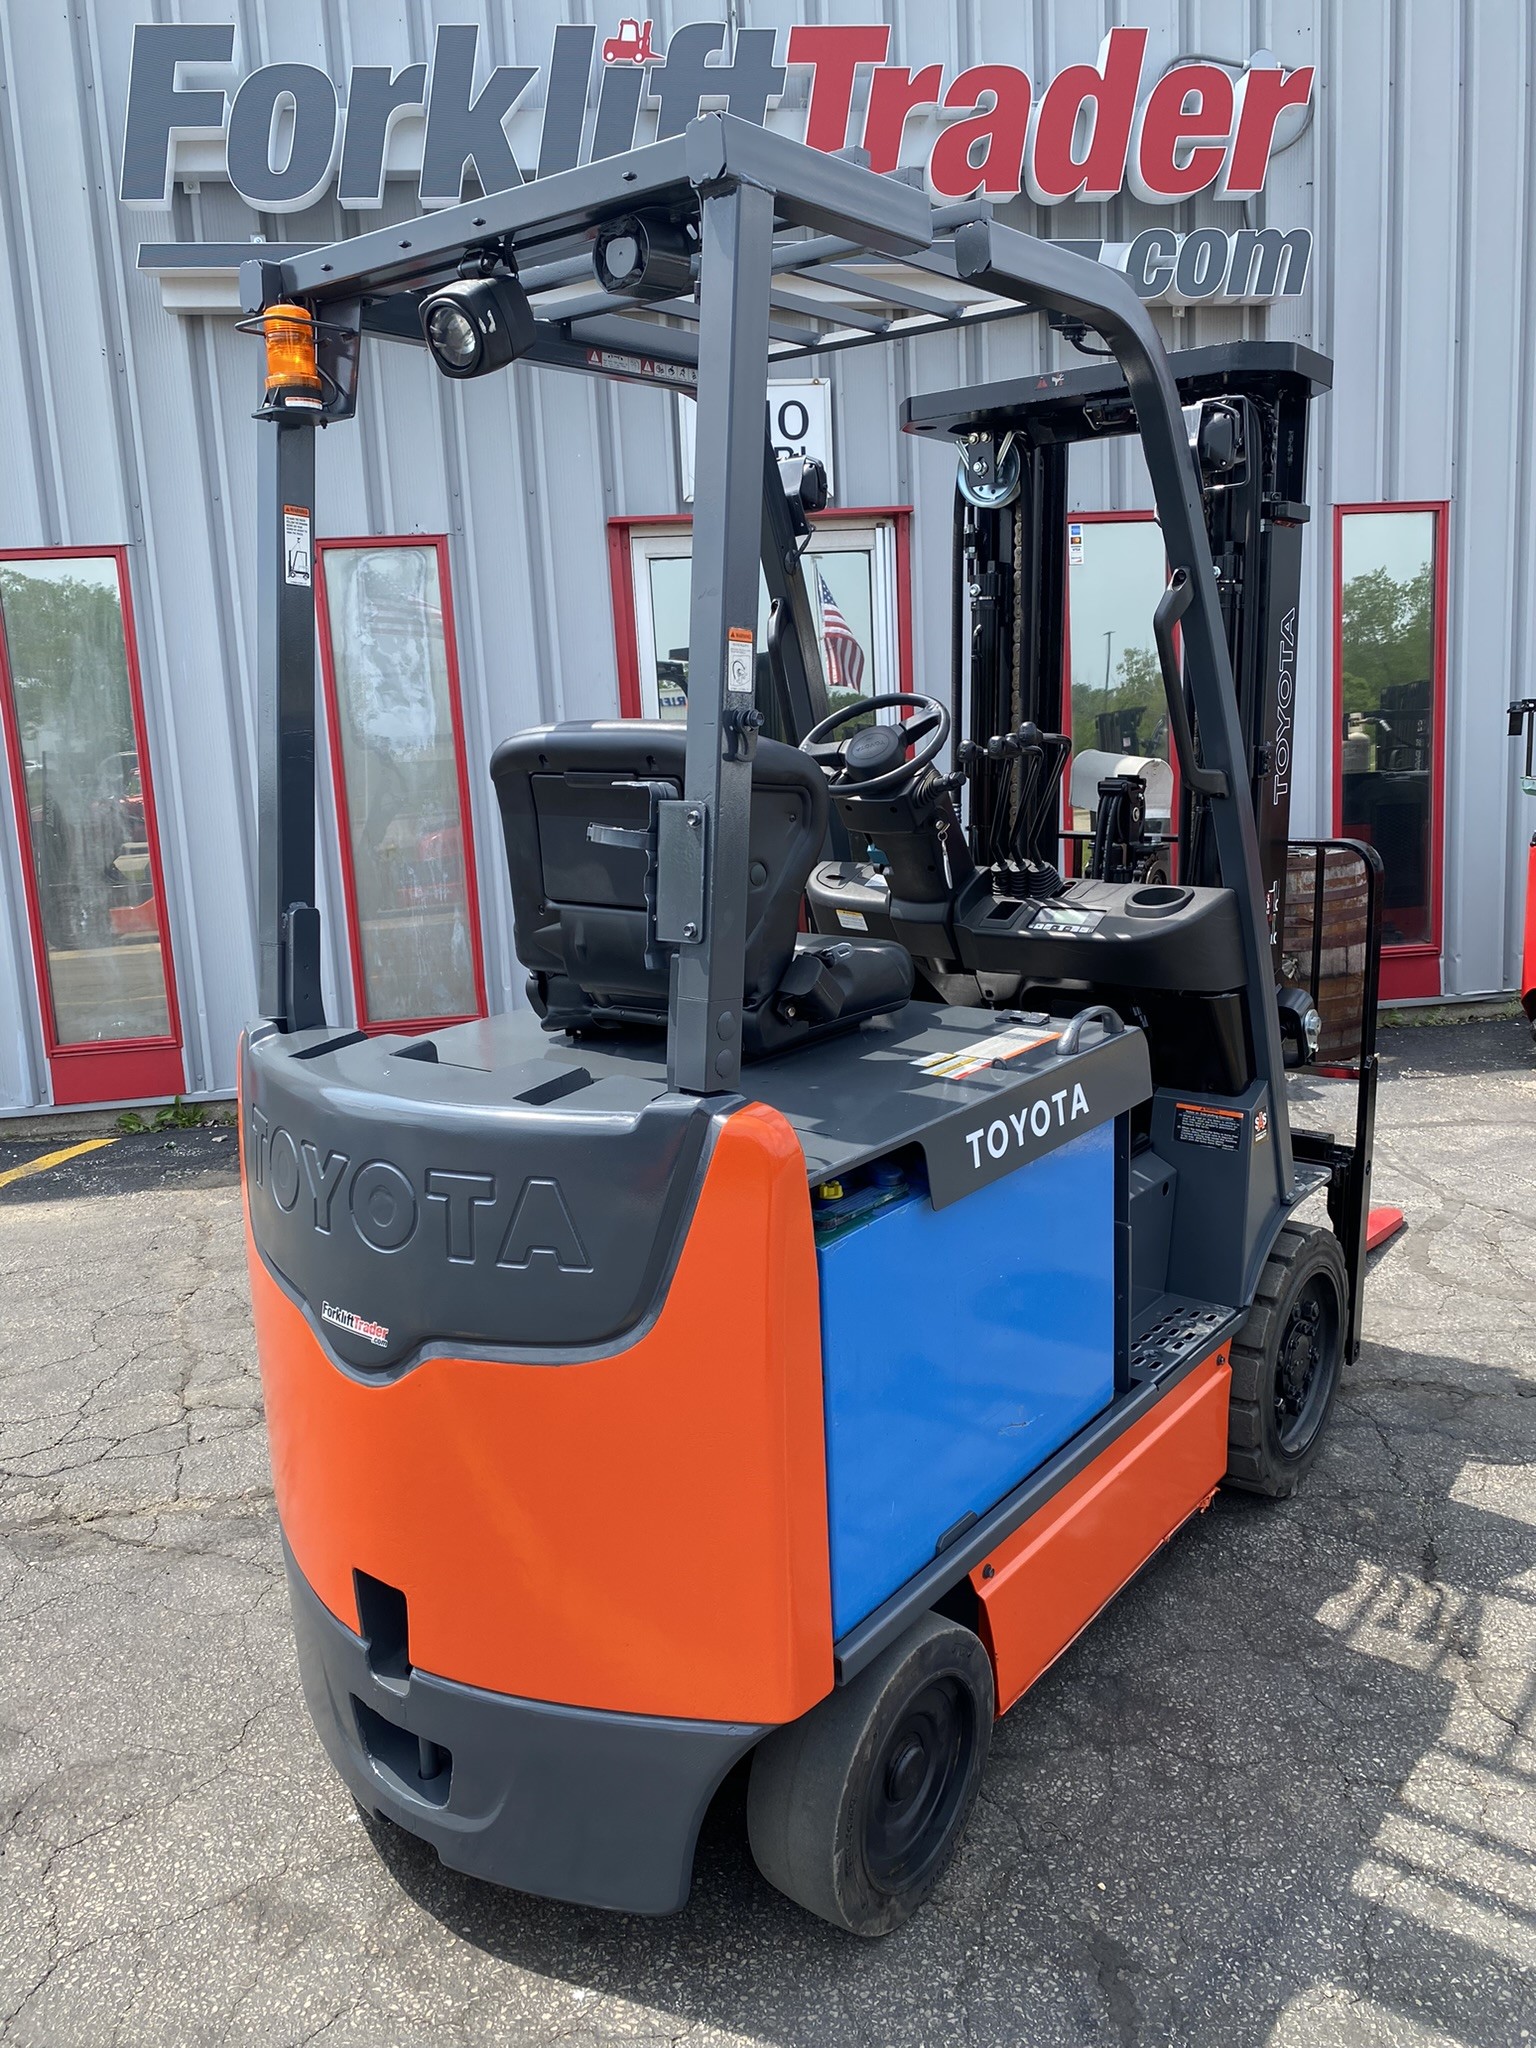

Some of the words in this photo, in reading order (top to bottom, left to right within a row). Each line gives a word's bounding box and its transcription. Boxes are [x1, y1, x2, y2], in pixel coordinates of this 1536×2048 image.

[1273, 607, 1296, 806] TOYOTA
[252, 1106, 594, 1274] TOYOTA
[965, 1082, 1090, 1169] TOYOTA
